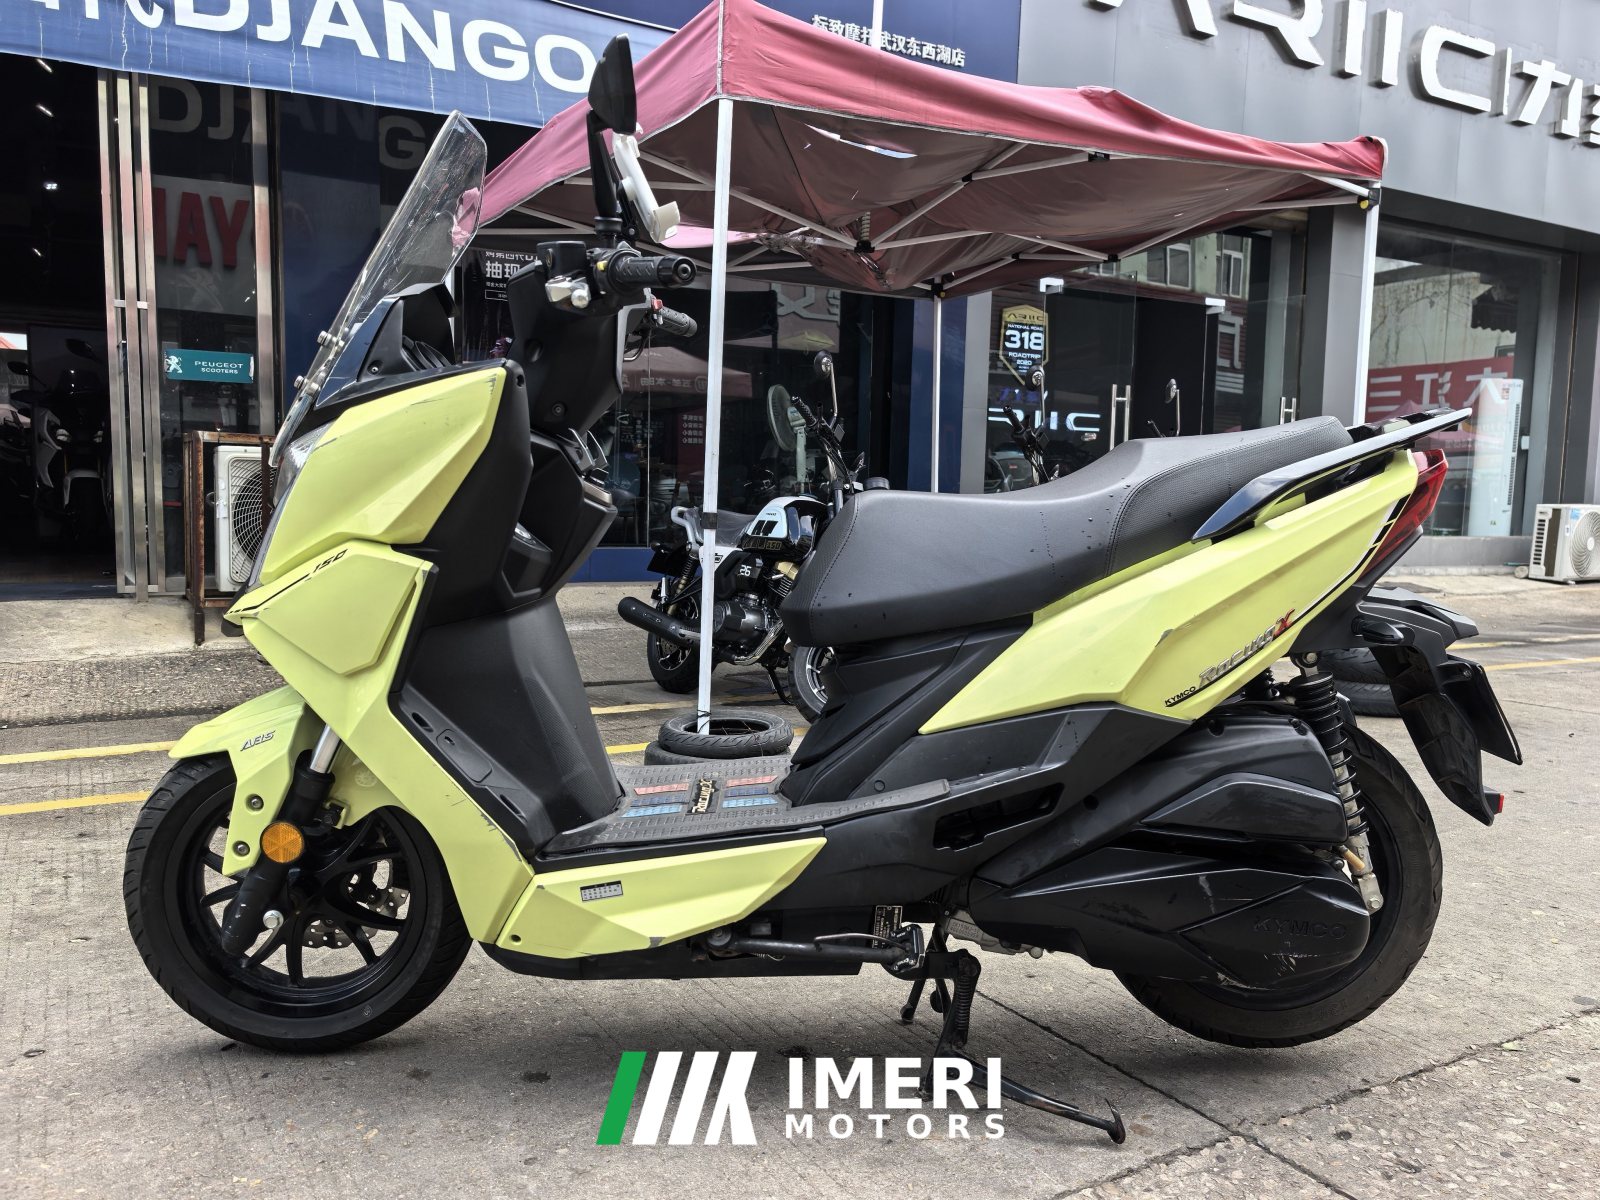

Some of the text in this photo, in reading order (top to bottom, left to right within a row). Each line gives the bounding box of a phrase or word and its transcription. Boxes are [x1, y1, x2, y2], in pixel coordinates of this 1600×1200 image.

[1004, 329, 1044, 351] 318
[194, 360, 244, 368] PEUGEOT
[1008, 352, 1041, 360] ROADTRIP
[201, 367, 239, 375] SCOOTERS
[312, 548, 349, 574] 150
[1164, 686, 1197, 706] KYMCO
[1253, 914, 1348, 940] KYMCO
